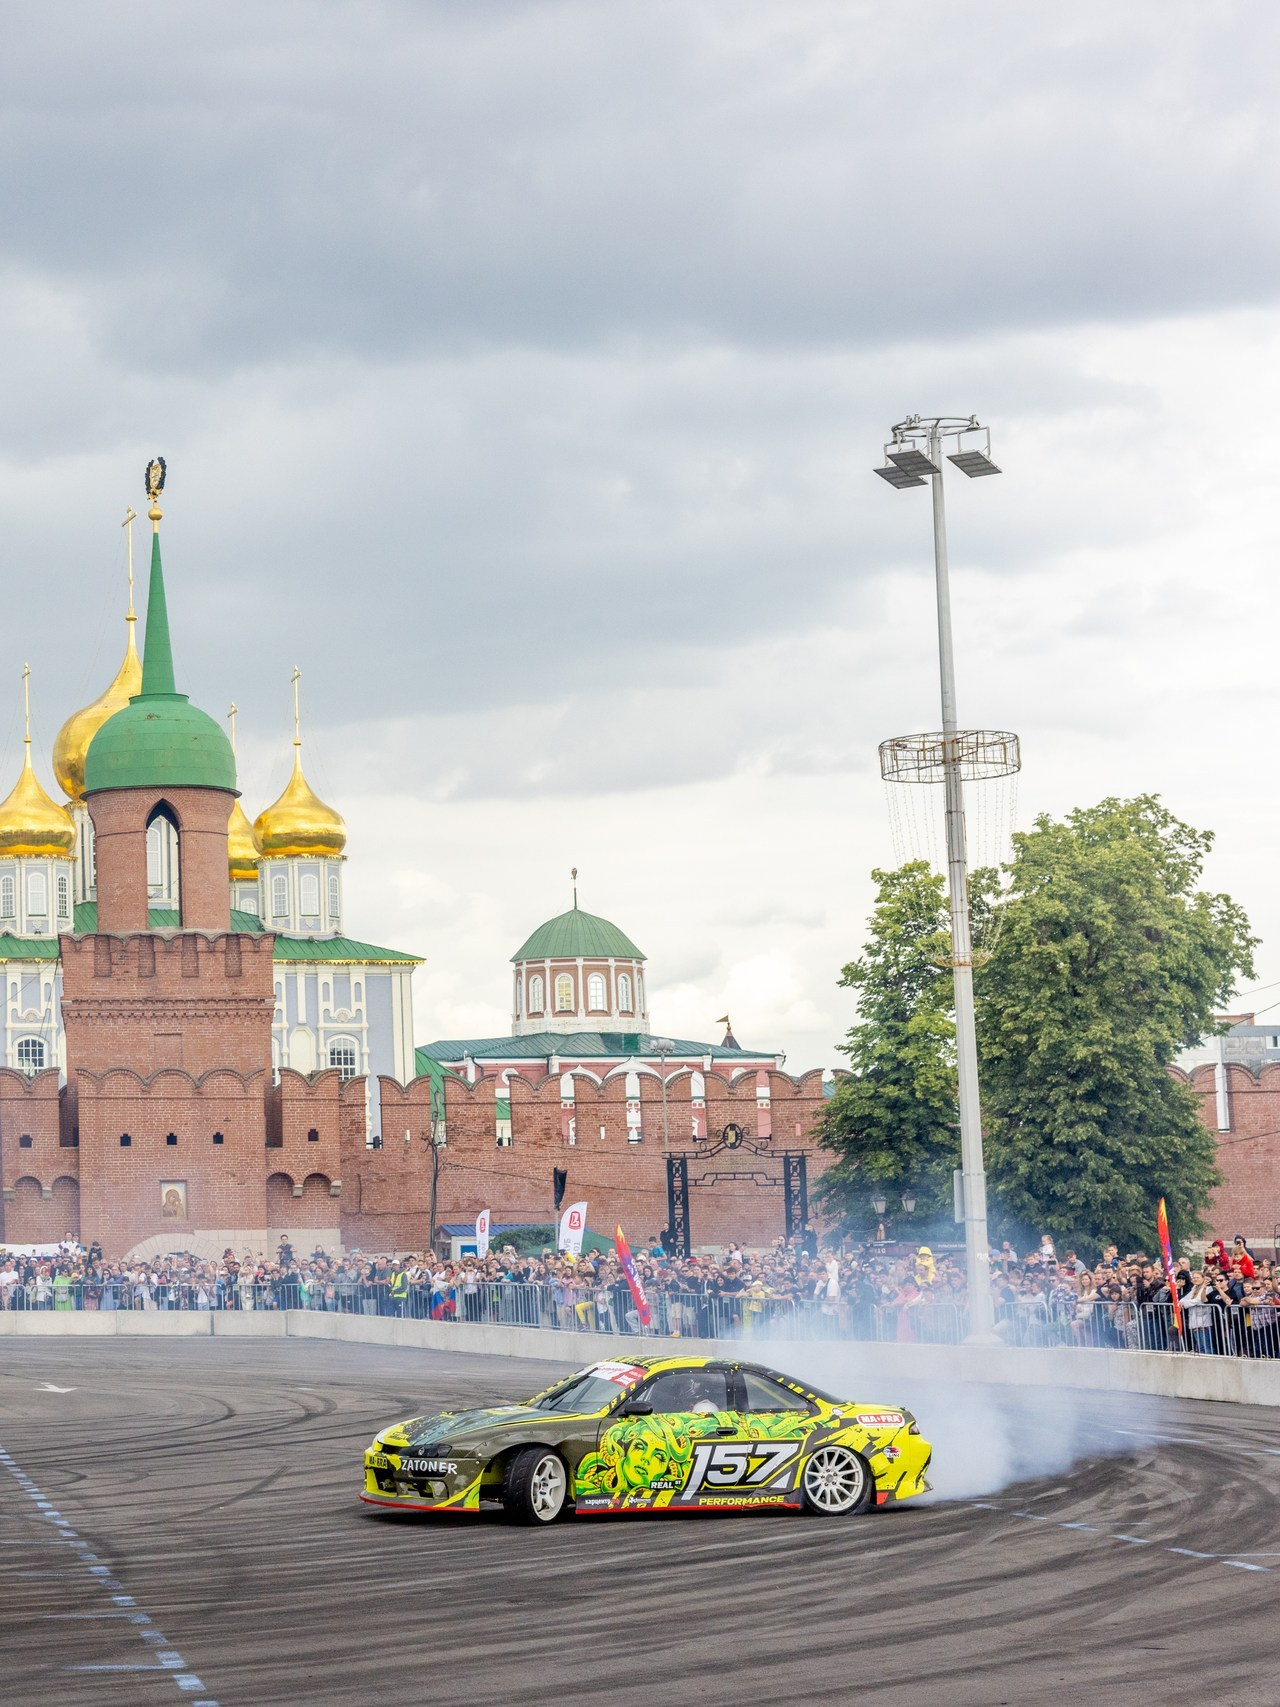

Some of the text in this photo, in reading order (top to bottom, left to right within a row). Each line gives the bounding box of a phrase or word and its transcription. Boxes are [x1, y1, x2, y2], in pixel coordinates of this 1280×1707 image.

[401, 1459, 458, 1475] ZATONER
[681, 1443, 799, 1500] 157
[650, 1481, 674, 1489] REAL
[698, 1495, 785, 1506] PERFORMANCE
